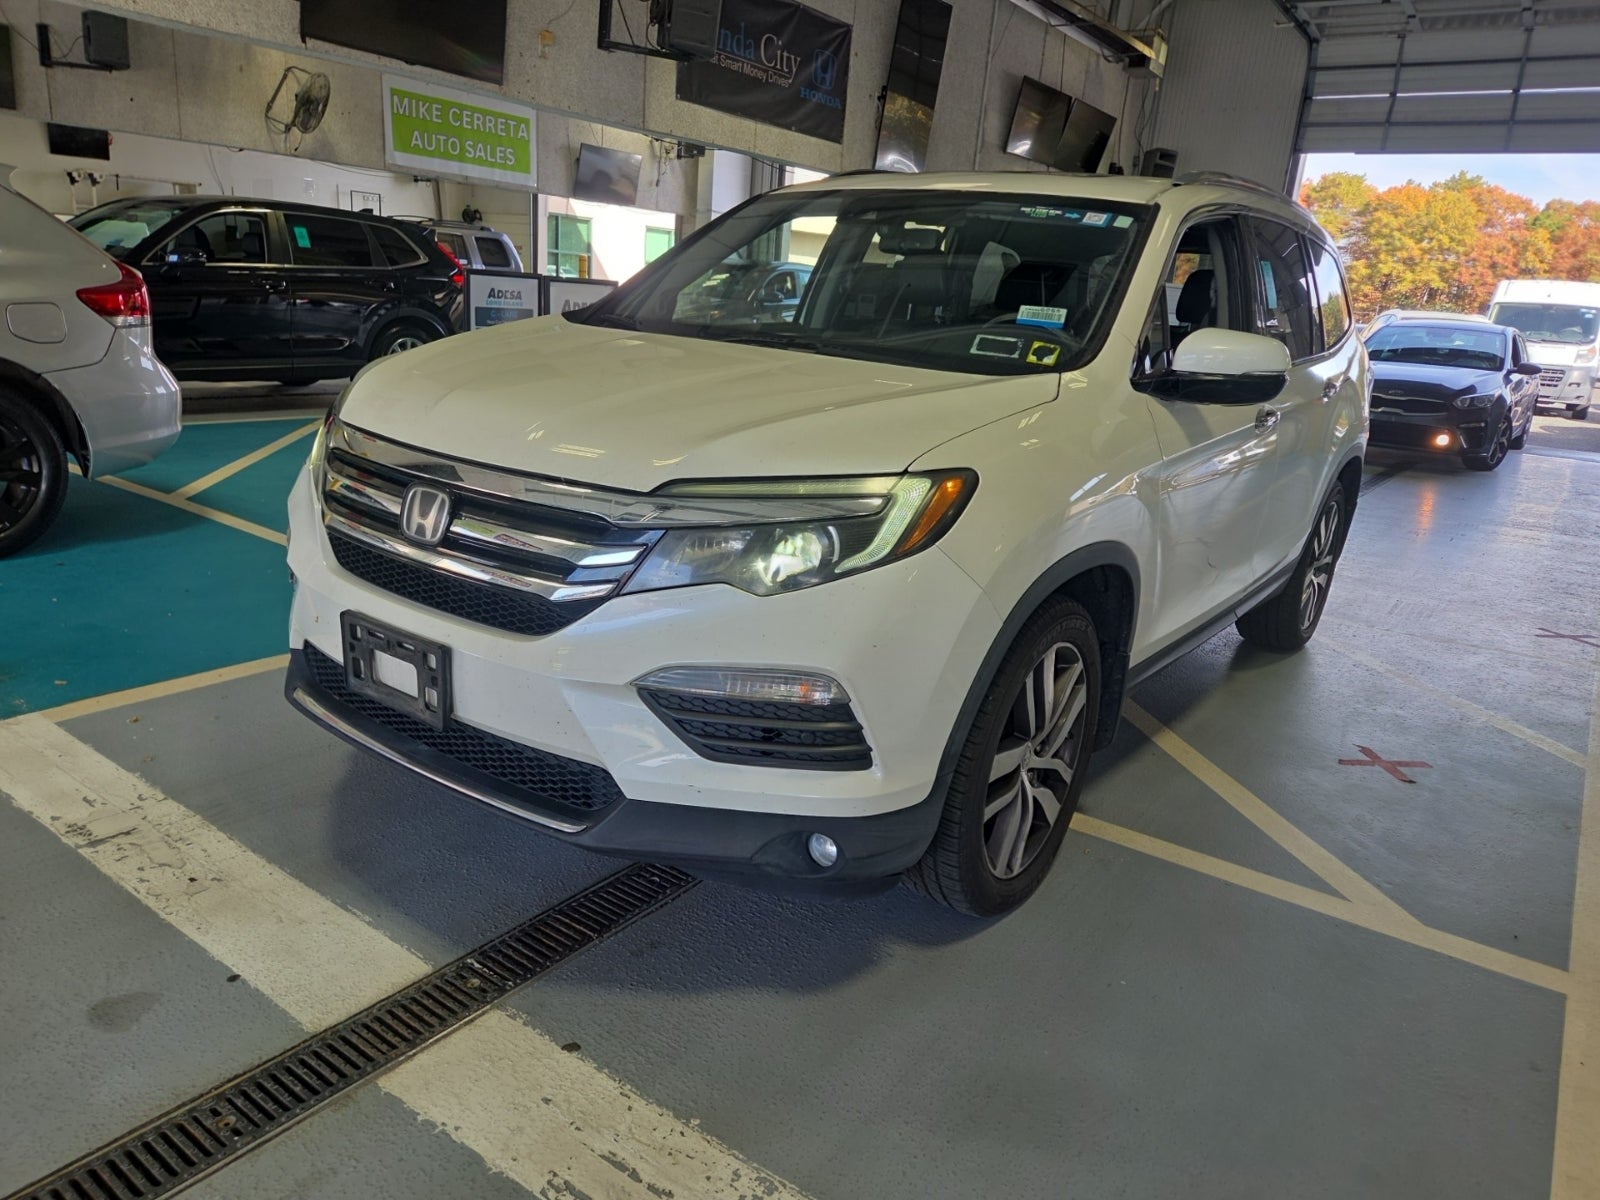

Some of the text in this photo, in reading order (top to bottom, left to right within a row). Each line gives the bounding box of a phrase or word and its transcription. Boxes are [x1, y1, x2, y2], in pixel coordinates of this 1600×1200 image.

[718, 22, 801, 83] nda City
[720, 55, 743, 73] Smart
[743, 63, 767, 83] Money
[768, 71, 790, 88] Drives
[800, 86, 842, 109] HONDA
[393, 95, 529, 140] MIKE CERRETA
[411, 130, 515, 165] AUTO SALES
